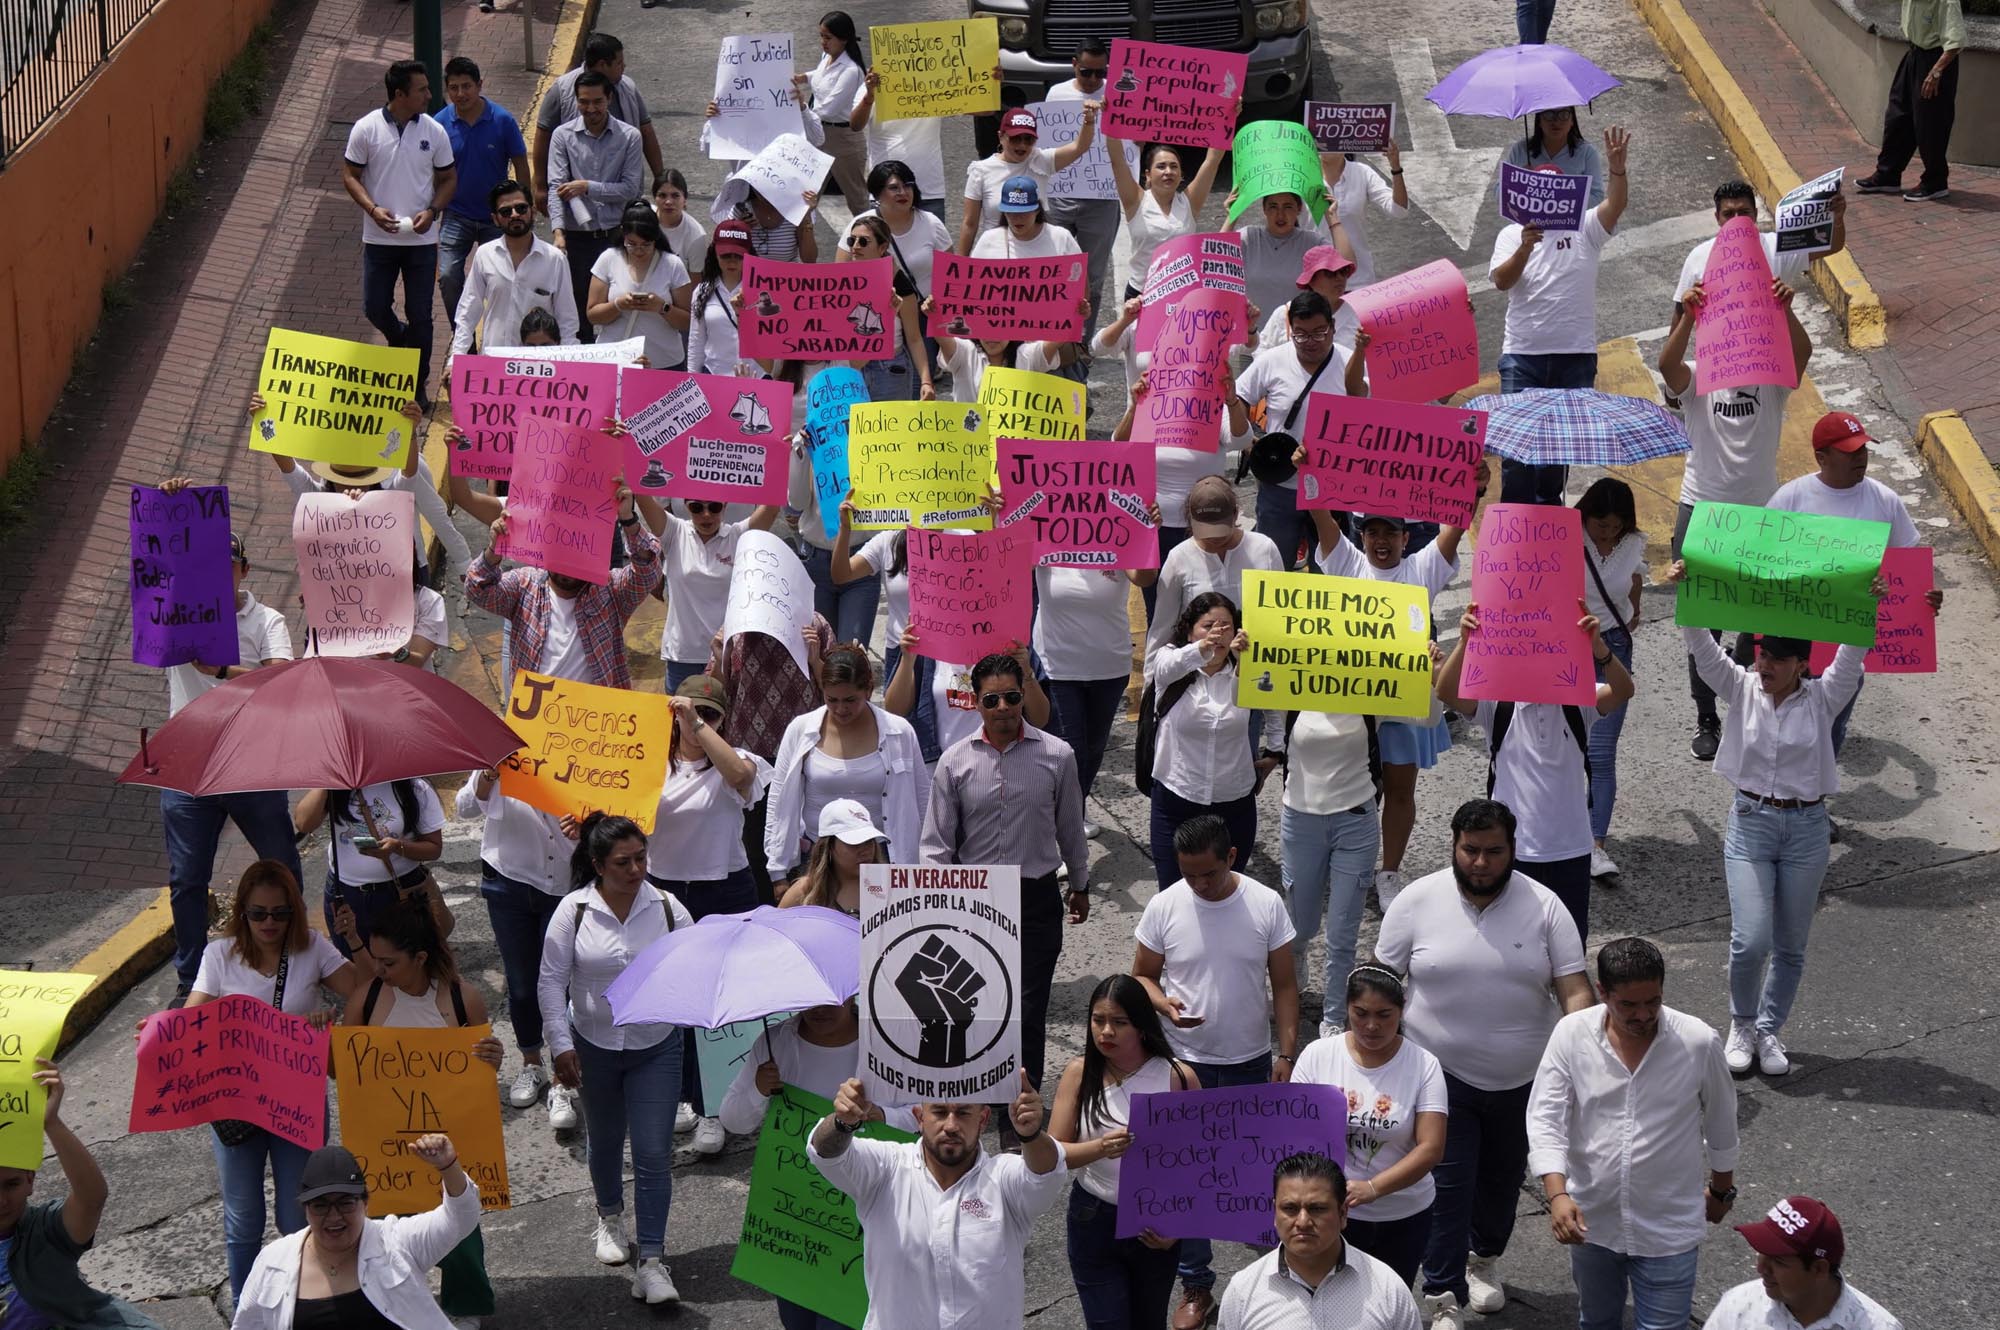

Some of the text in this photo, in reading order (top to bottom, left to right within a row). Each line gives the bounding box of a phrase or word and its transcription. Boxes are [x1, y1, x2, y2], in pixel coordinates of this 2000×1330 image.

[750, 39, 792, 63] Judicial
[872, 25, 967, 56] Ministros al
[881, 48, 966, 74] servicio del
[1123, 47, 1211, 75] Elección
[733, 74, 755, 91] sin
[947, 66, 990, 87] de los
[1146, 73, 1220, 95] popular
[1112, 92, 1133, 108] de
[1315, 106, 1387, 120] ¡JUSTICIA
[1109, 112, 1216, 132] Magistrados
[1223, 125, 1234, 141] y
[1151, 130, 1211, 148] Jueces
[1315, 123, 1386, 138] TODOS!
[1510, 170, 1577, 190] ¡JUSTICIA
[1525, 186, 1556, 199] PARA
[1507, 188, 1577, 214] TODOS!
[718, 227, 749, 240] morena
[1779, 212, 1832, 230] JUDICIAL
[1203, 240, 1242, 259] JUSTICIA
[749, 266, 868, 292] IMPUNIDAD
[946, 262, 960, 279] A
[1039, 264, 1062, 280] DE
[1202, 260, 1245, 279] para TODOS
[943, 282, 1069, 303] ELIMINAR
[1157, 271, 1197, 297] EFICIENTE
[1204, 278, 1246, 293] #Veracruz
[793, 294, 852, 311] CERO
[1369, 295, 1451, 328] REFORMA
[758, 318, 832, 335] NO AL
[1411, 321, 1424, 335] al
[782, 336, 884, 354] SABADAZO
[1164, 347, 1215, 366] CON LA
[1382, 331, 1449, 358] PODER
[269, 347, 415, 393] TRANSPARENCIA
[506, 362, 553, 377] Sí a la
[1386, 347, 1467, 380] JUDICIAL
[266, 379, 292, 395] EN
[297, 382, 318, 400] EL
[463, 369, 589, 401] ELECCIÓN
[660, 376, 697, 407] austeridad
[1149, 368, 1214, 391] REFORMA
[982, 371, 1064, 415] JUSTICIA
[277, 400, 385, 436] TRIBUNAL
[469, 402, 517, 427] POR
[638, 401, 685, 436] transparencia
[1151, 393, 1214, 424] JUDICIAL
[1713, 401, 1755, 417] PUMA
[855, 410, 958, 436] Nadie debe
[523, 417, 593, 464] PODER
[638, 427, 678, 456] Máximo
[689, 437, 765, 456] Luchemos
[1317, 409, 1482, 466] LEGITIMIDAD
[688, 456, 764, 473] INDEPENDENCIA
[709, 451, 743, 461] por una
[860, 440, 989, 465] ganar que
[533, 457, 605, 493] JUDICIAL
[688, 469, 763, 486] JUDICIAL
[1010, 454, 1136, 487] JUSTICIA
[1316, 447, 1468, 488] DEMOCRATICA
[191, 489, 229, 520] YA
[862, 490, 977, 509] sin excepción
[1043, 491, 1107, 514] PARA
[1111, 491, 1151, 526] PODER
[1130, 495, 1143, 506] AL
[1353, 481, 1474, 514] a la Reforma
[301, 505, 397, 536] Ministros
[853, 509, 910, 523] PODER JUDICIAL
[922, 505, 991, 524] #ReformaYa
[1405, 505, 1465, 527] Judicial
[168, 526, 191, 555] el
[525, 519, 601, 556] NACIONAL
[1030, 516, 1131, 548] TODOS
[1705, 506, 1883, 560] NO Dispendios
[307, 536, 382, 560] al servicio
[908, 528, 1015, 569] El Pueblo ya
[1040, 552, 1116, 566] JUDICIAL
[1703, 537, 1845, 574] Ni derroches de
[132, 558, 176, 591] Poder
[311, 563, 336, 582] del
[1734, 560, 1832, 598] DINERO
[330, 584, 363, 604] NO
[911, 583, 998, 613] Democracia
[1257, 580, 1396, 620] LUCHEMOS
[1751, 588, 1778, 607] DE
[149, 596, 222, 627] Judicial
[325, 603, 383, 625] de los
[912, 611, 967, 637] dedazos
[318, 622, 408, 647] empresarios
[1282, 615, 1396, 640] POR UNA
[1252, 641, 1430, 673] INDEPENDENCIA
[1289, 668, 1404, 700] JUDICIAL
[511, 674, 638, 737] Jóvenes
[542, 731, 646, 761] podemos
[506, 751, 631, 790] ser jueces
[890, 868, 989, 890] EN VERACRUZ
[861, 893, 1019, 941] LUCHAMOS POR LA JUSTICIA
[156, 1000, 314, 1046] NO DERROCHES
[157, 1028, 322, 1078] NO PRIVILEGIOS
[347, 1031, 469, 1087] Relevo
[155, 1061, 260, 1099] #ReformaYa
[867, 1051, 1016, 1099] ELLOS POR PRIVILEGIOS
[391, 1086, 442, 1130] YA
[1147, 1093, 1321, 1128] Independencia
[267, 1111, 308, 1144] Todos
[1201, 1118, 1238, 1142] del
[379, 1138, 409, 1158] en
[1141, 1143, 1224, 1170] Poder
[1198, 1166, 1239, 1190] del
[1134, 1187, 1196, 1217] Poder
